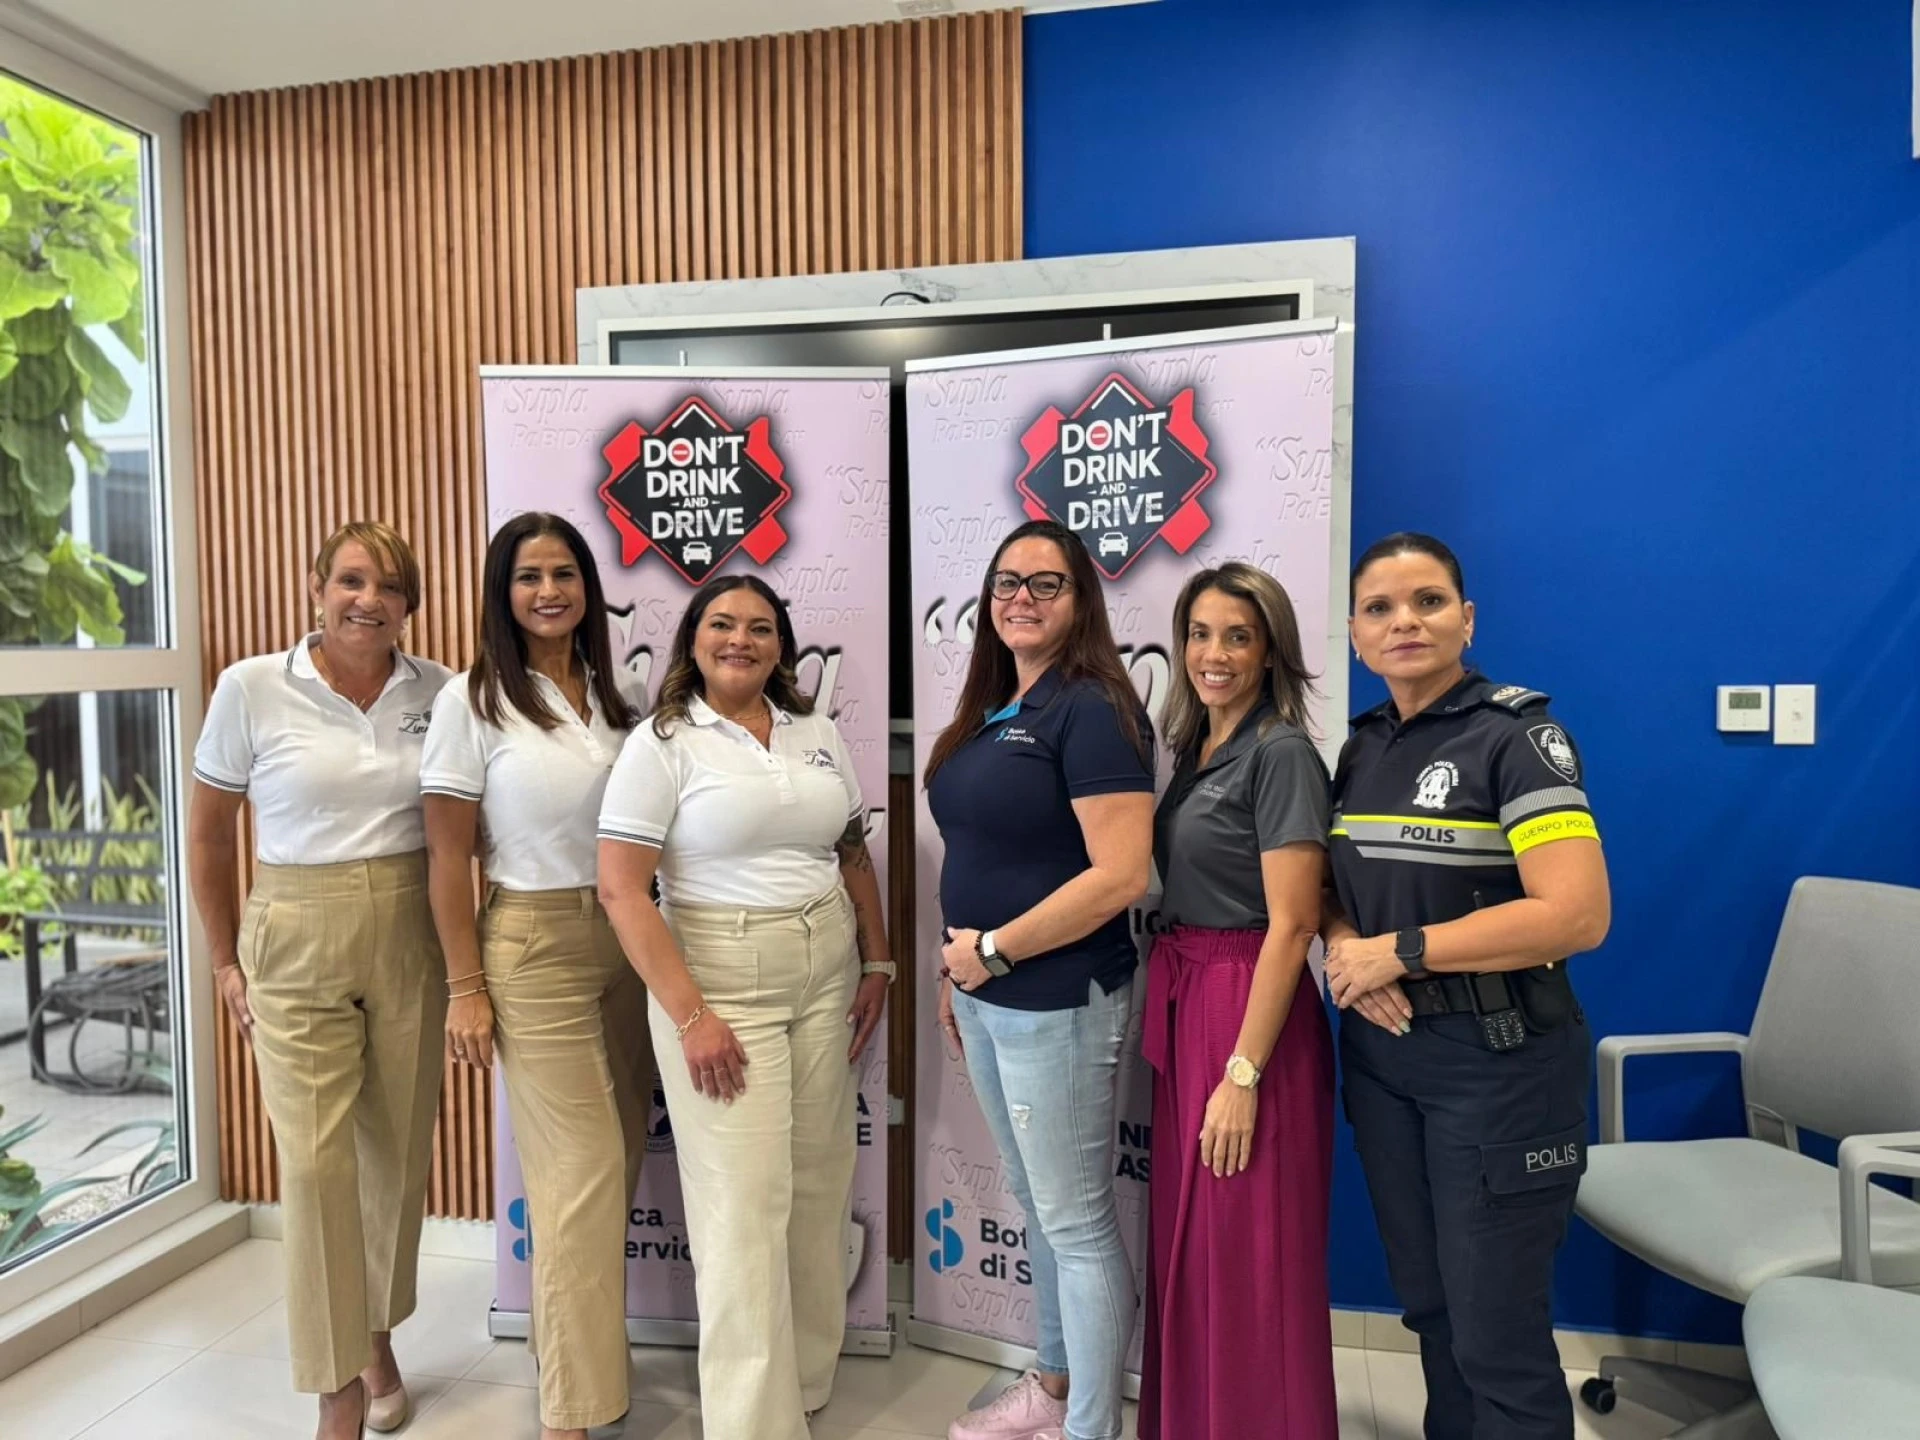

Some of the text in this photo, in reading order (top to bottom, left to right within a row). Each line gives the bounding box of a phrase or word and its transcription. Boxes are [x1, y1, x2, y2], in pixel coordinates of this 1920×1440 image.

[1061, 411, 1167, 455] DON'T
[643, 436, 745, 468] DON'T
[1063, 446, 1162, 488] DRINK
[646, 466, 742, 499] DRINK
[1100, 482, 1127, 496] AND
[682, 496, 709, 509] AND
[1068, 491, 1164, 531] DRIVE
[652, 507, 744, 539] DRIVE
[1400, 825, 1456, 844] POLIS
[1525, 1143, 1578, 1170] POLIS
[980, 1253, 1007, 1279] di
